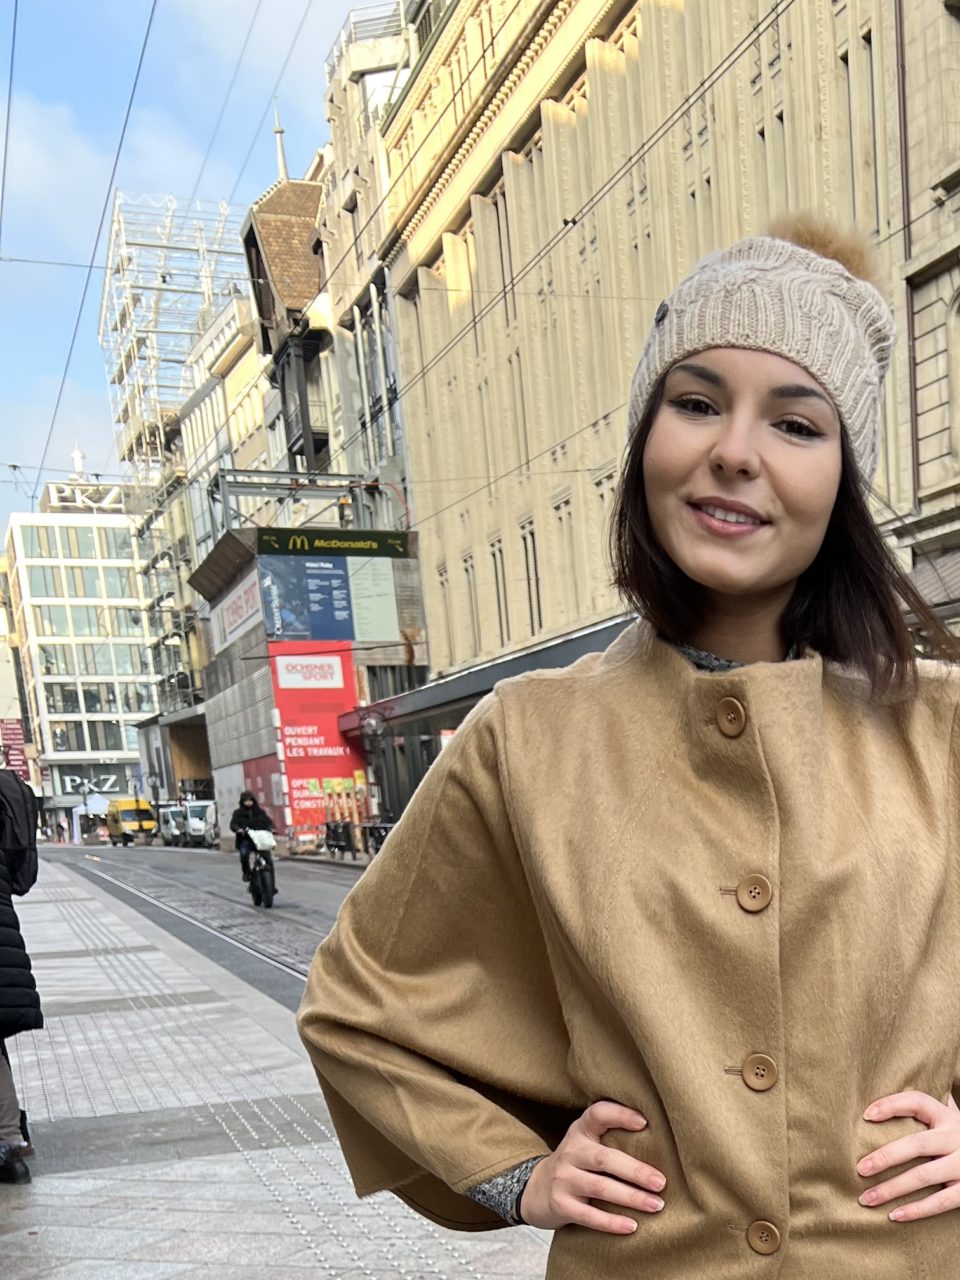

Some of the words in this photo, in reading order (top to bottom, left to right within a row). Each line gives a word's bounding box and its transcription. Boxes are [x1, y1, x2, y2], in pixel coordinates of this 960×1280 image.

[313, 538, 379, 549] McDonald's
[285, 663, 334, 673] OCHSNER
[303, 672, 334, 681] SPORT
[284, 726, 318, 736] OUVERT
[284, 736, 325, 746] PENDANT
[286, 747, 305, 757] LES
[307, 746, 344, 757] TRAVAUX
[62, 774, 120, 793] PKZ
